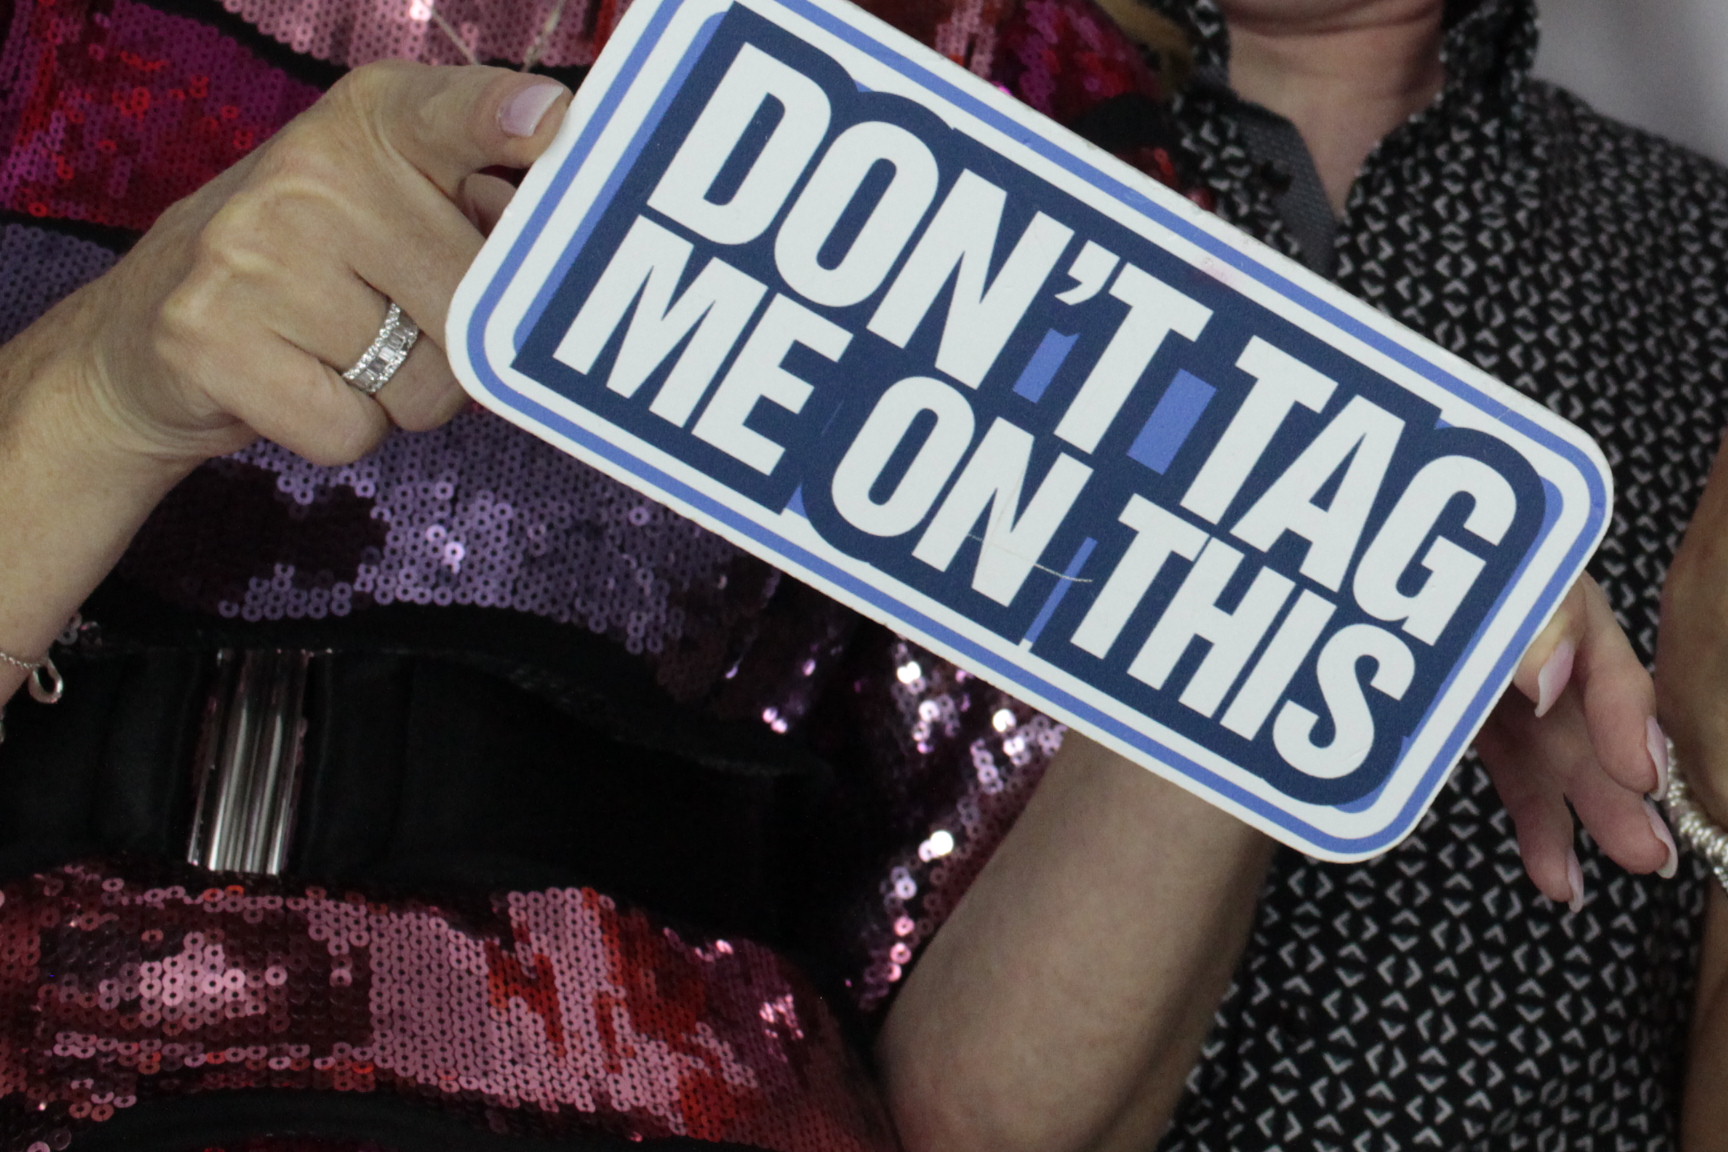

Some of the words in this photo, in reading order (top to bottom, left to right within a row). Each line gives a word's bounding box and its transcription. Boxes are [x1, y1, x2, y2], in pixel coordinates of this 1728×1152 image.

[552, 216, 853, 477] ME
[830, 376, 1094, 608] ON
[1069, 491, 1416, 779] THIS
[645, 41, 1214, 455] DON'T
[1179, 335, 1517, 646] TAG
